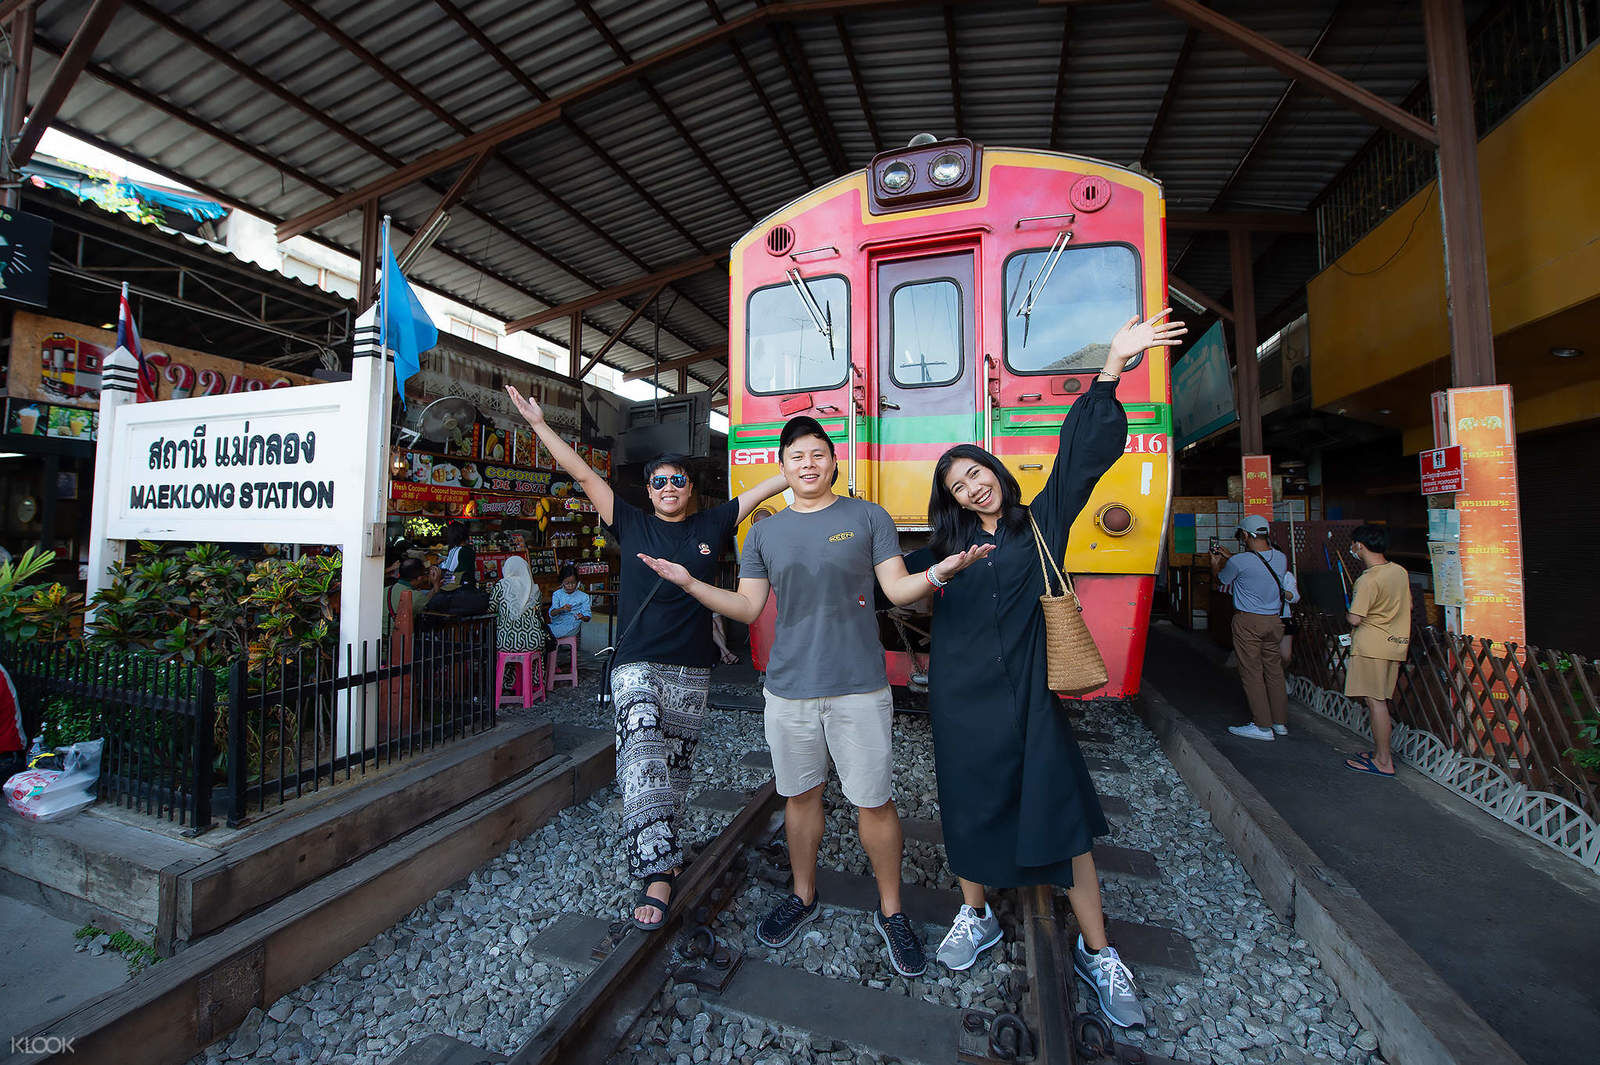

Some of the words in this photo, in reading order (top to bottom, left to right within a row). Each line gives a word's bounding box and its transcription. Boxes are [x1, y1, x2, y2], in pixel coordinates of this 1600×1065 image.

[149, 424, 207, 469] สถานี
[215, 421, 316, 467] แม่กลอง
[130, 483, 236, 510] MAEKLONG
[239, 480, 335, 509] STATION
